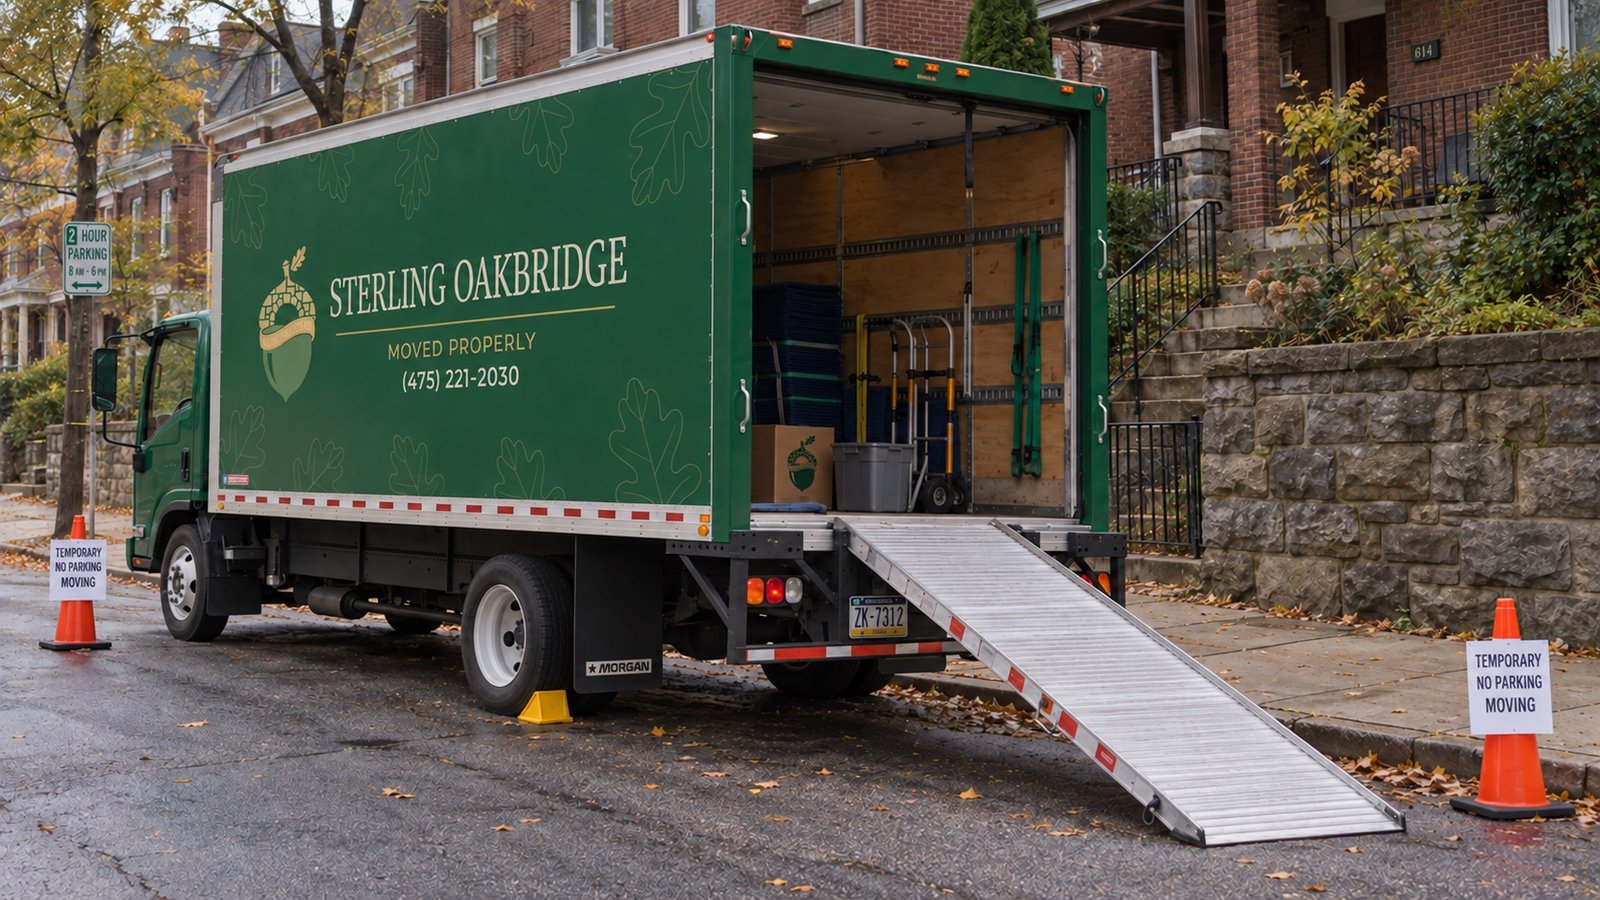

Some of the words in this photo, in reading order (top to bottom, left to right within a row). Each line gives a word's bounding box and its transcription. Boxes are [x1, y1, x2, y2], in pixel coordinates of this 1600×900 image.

[1415, 44, 1432, 58] 614
[68, 228, 76, 242] 2
[82, 230, 107, 242] HOUR
[68, 248, 107, 260] PARKING
[330, 263, 446, 318] STERLING
[454, 236, 628, 303] OAKBRIDGE
[388, 340, 443, 360] MOVED
[449, 332, 536, 356] PROPERLY
[402, 369, 440, 393] (475)
[445, 365, 520, 389] 221-2030
[56, 548, 102, 558] TEMPORARY
[55, 562, 66, 572] NO
[68, 562, 102, 572] PARKING
[60, 576, 96, 588] MOVING
[854, 606, 904, 628] ZK-7312
[598, 661, 650, 674] MORGAN
[1475, 653, 1542, 668] TEMPORARY
[1476, 676, 1492, 690] NO
[1495, 675, 1542, 689] PARKING
[1486, 697, 1536, 713] MOVING
